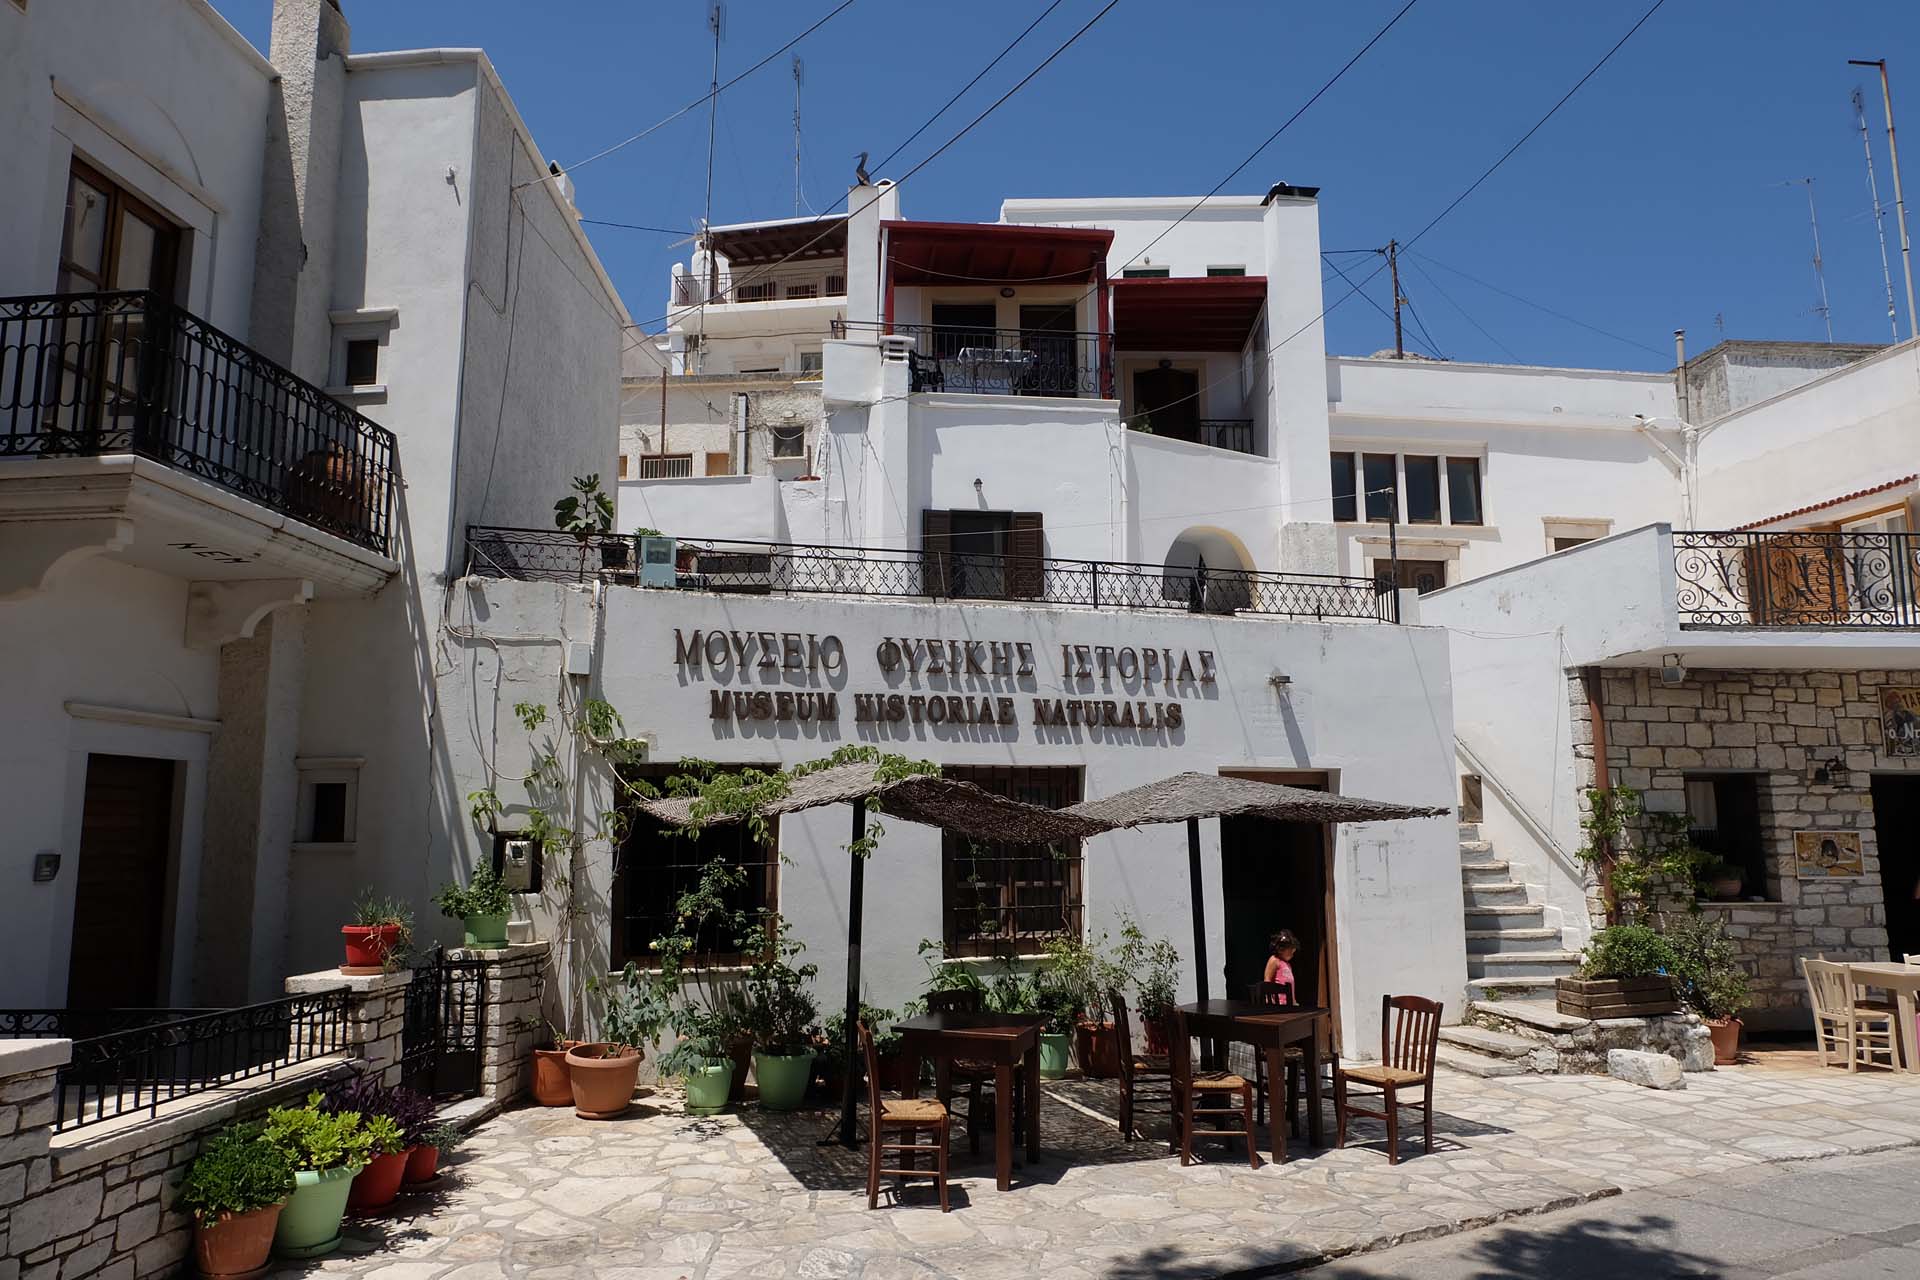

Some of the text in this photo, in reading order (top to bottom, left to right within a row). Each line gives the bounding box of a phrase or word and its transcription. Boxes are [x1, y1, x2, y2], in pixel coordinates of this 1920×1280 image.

[673, 628, 1216, 683] ΜΟΥΣΕΙΟ ΦΥΣΙΚΗΣ ΙΣΤΟΡΙΑΣ
[709, 689, 1183, 731] MUSEUM HISTORIAE NATURALIS
